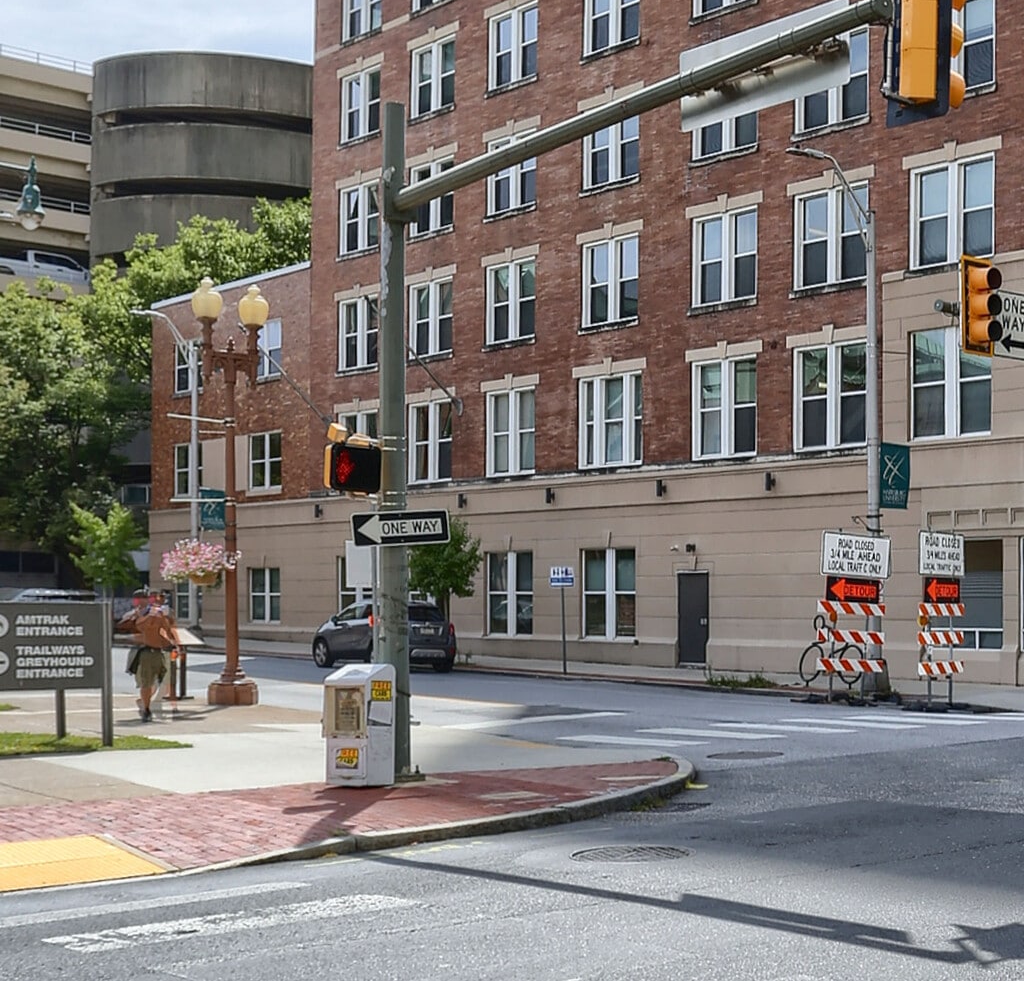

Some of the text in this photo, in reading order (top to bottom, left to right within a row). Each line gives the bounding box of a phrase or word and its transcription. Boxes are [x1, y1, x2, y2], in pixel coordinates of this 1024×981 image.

[382, 520, 438, 535] ONE WAY
[838, 538, 875, 551] ROAD CLOSED
[857, 551, 881, 562] AHEAD
[828, 560, 845, 571] LOCAL
[868, 563, 882, 575] ONLY
[843, 585, 877, 597] DETOUR
[934, 584, 958, 597] DETOUR
[15, 615, 70, 625] AMTRAK
[16, 626, 84, 636] ENTRANCE
[15, 645, 85, 656] TRAILWAYS
[16, 656, 94, 667] GREYHOUND
[16, 668, 84, 678] ENTRANCE
